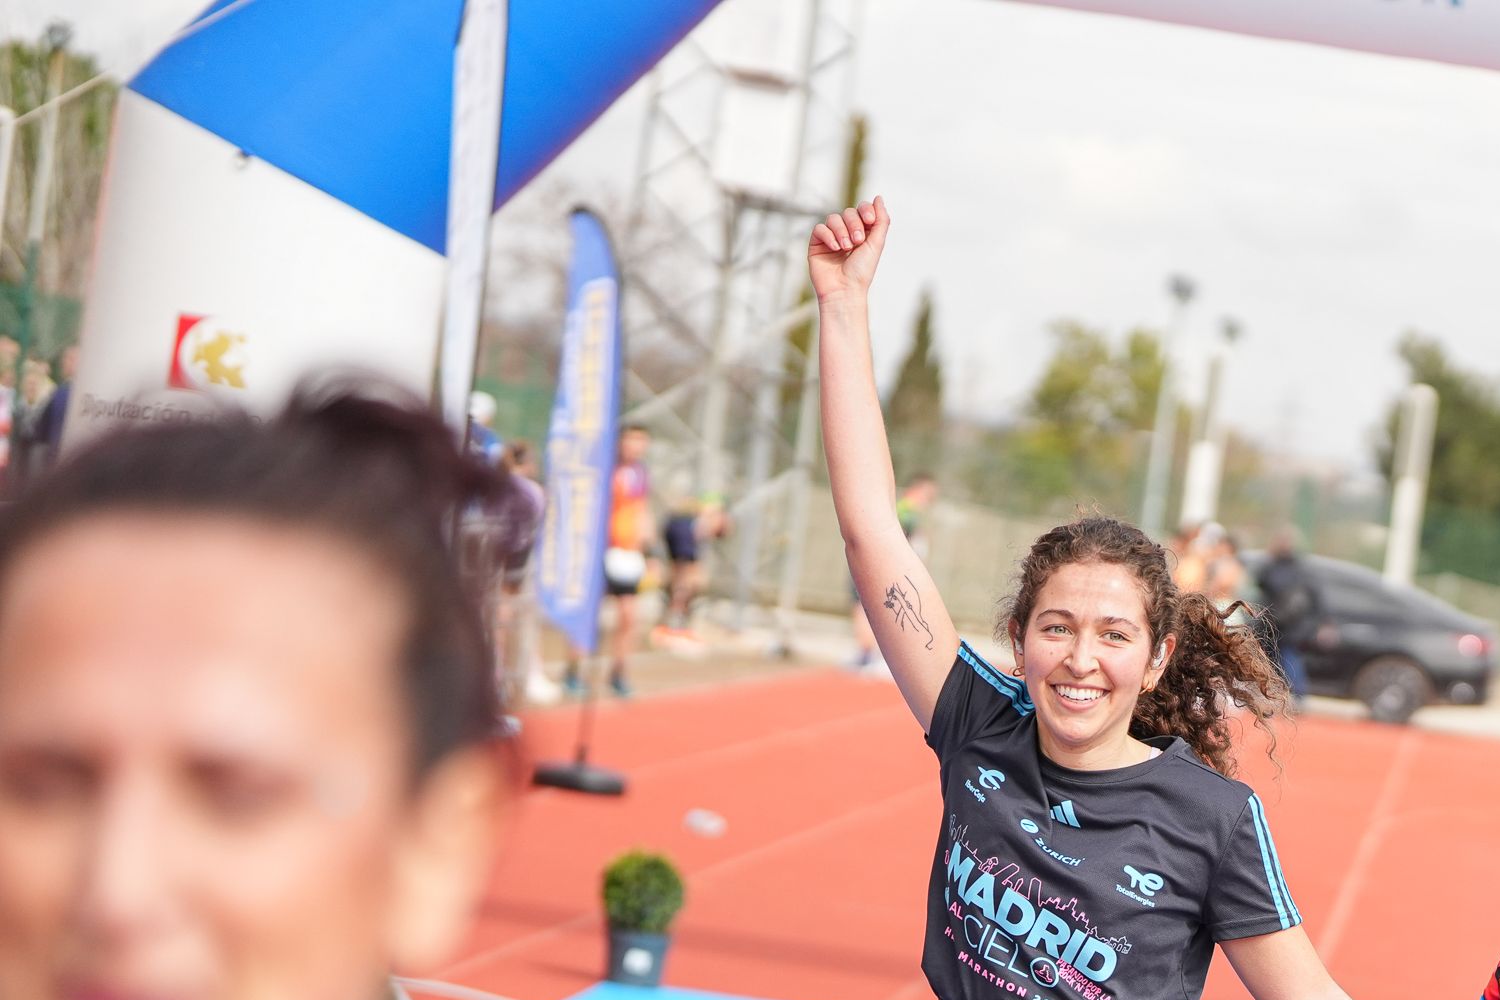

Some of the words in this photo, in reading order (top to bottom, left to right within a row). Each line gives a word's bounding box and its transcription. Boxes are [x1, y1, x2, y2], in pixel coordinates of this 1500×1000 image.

[1034, 837, 1081, 867] ZURICH
[948, 901, 963, 921] AL
[1115, 884, 1156, 908] TotalEnergies
[947, 840, 1118, 983] MADRID
[963, 914, 1060, 988] CIELO
[957, 951, 1028, 998] MARATHON
[1056, 958, 1088, 985] PASANDO
